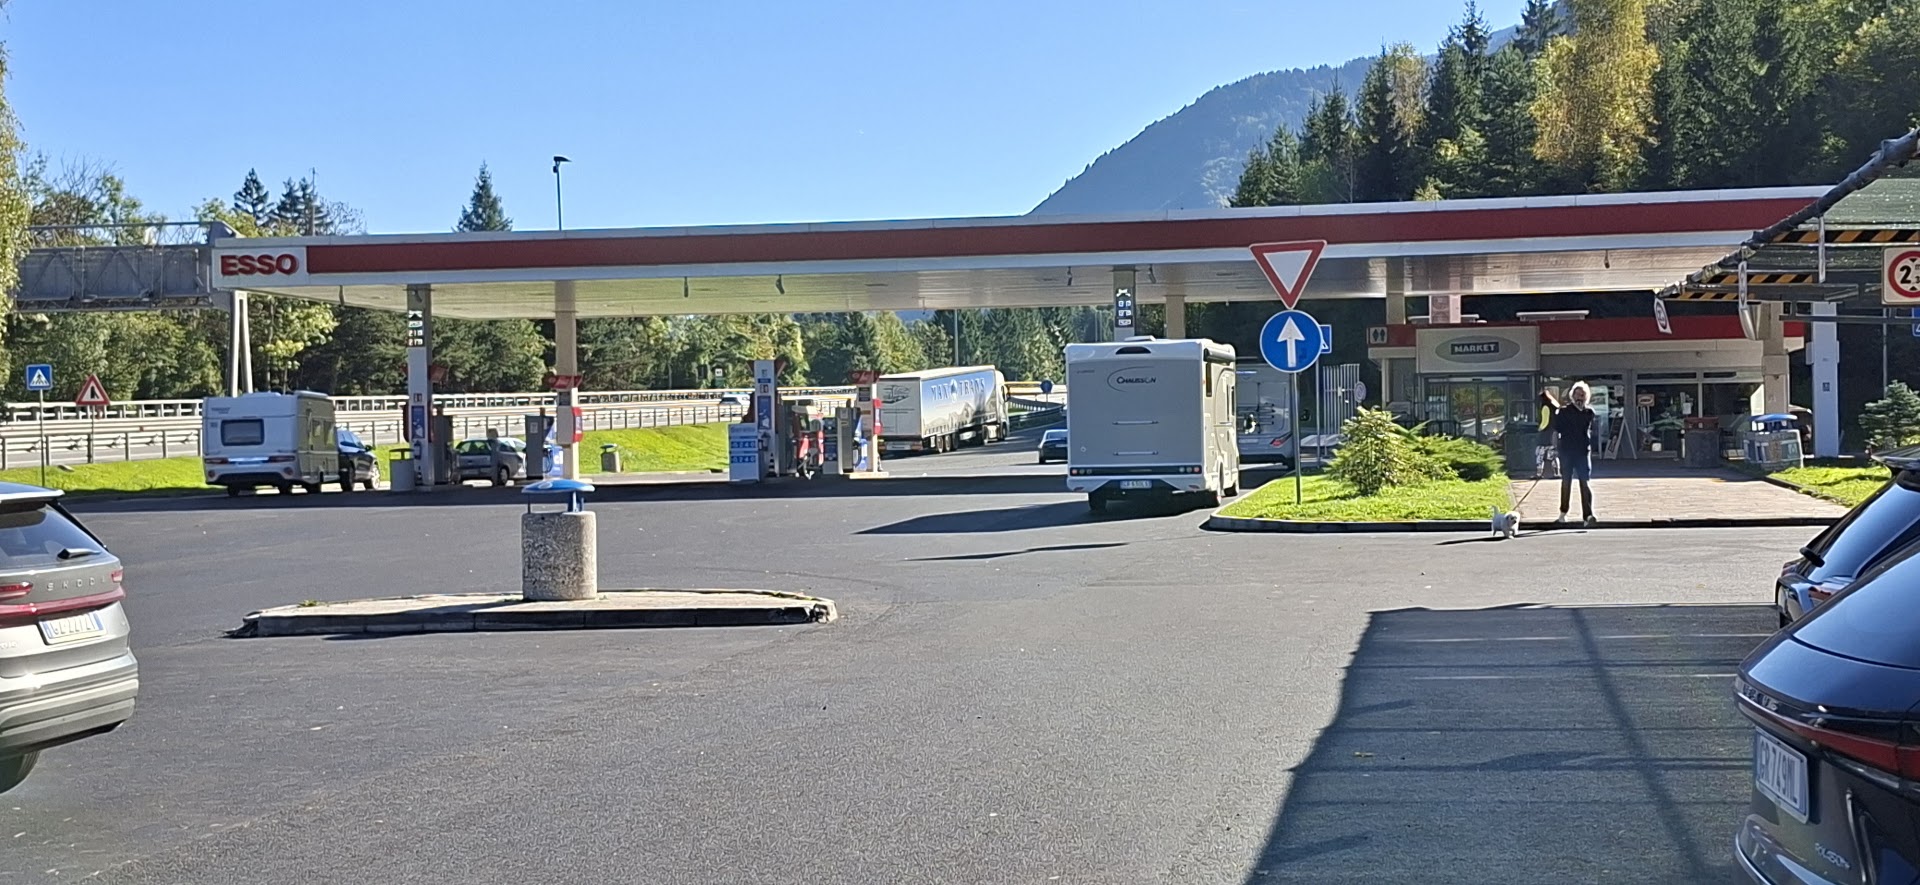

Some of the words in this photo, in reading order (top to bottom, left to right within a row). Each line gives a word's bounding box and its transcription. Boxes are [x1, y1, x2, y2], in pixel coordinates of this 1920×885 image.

[220, 253, 299, 276] ESSO
[1454, 344, 1496, 353] MARKET
[1116, 376, 1157, 384] CHAUSSON
